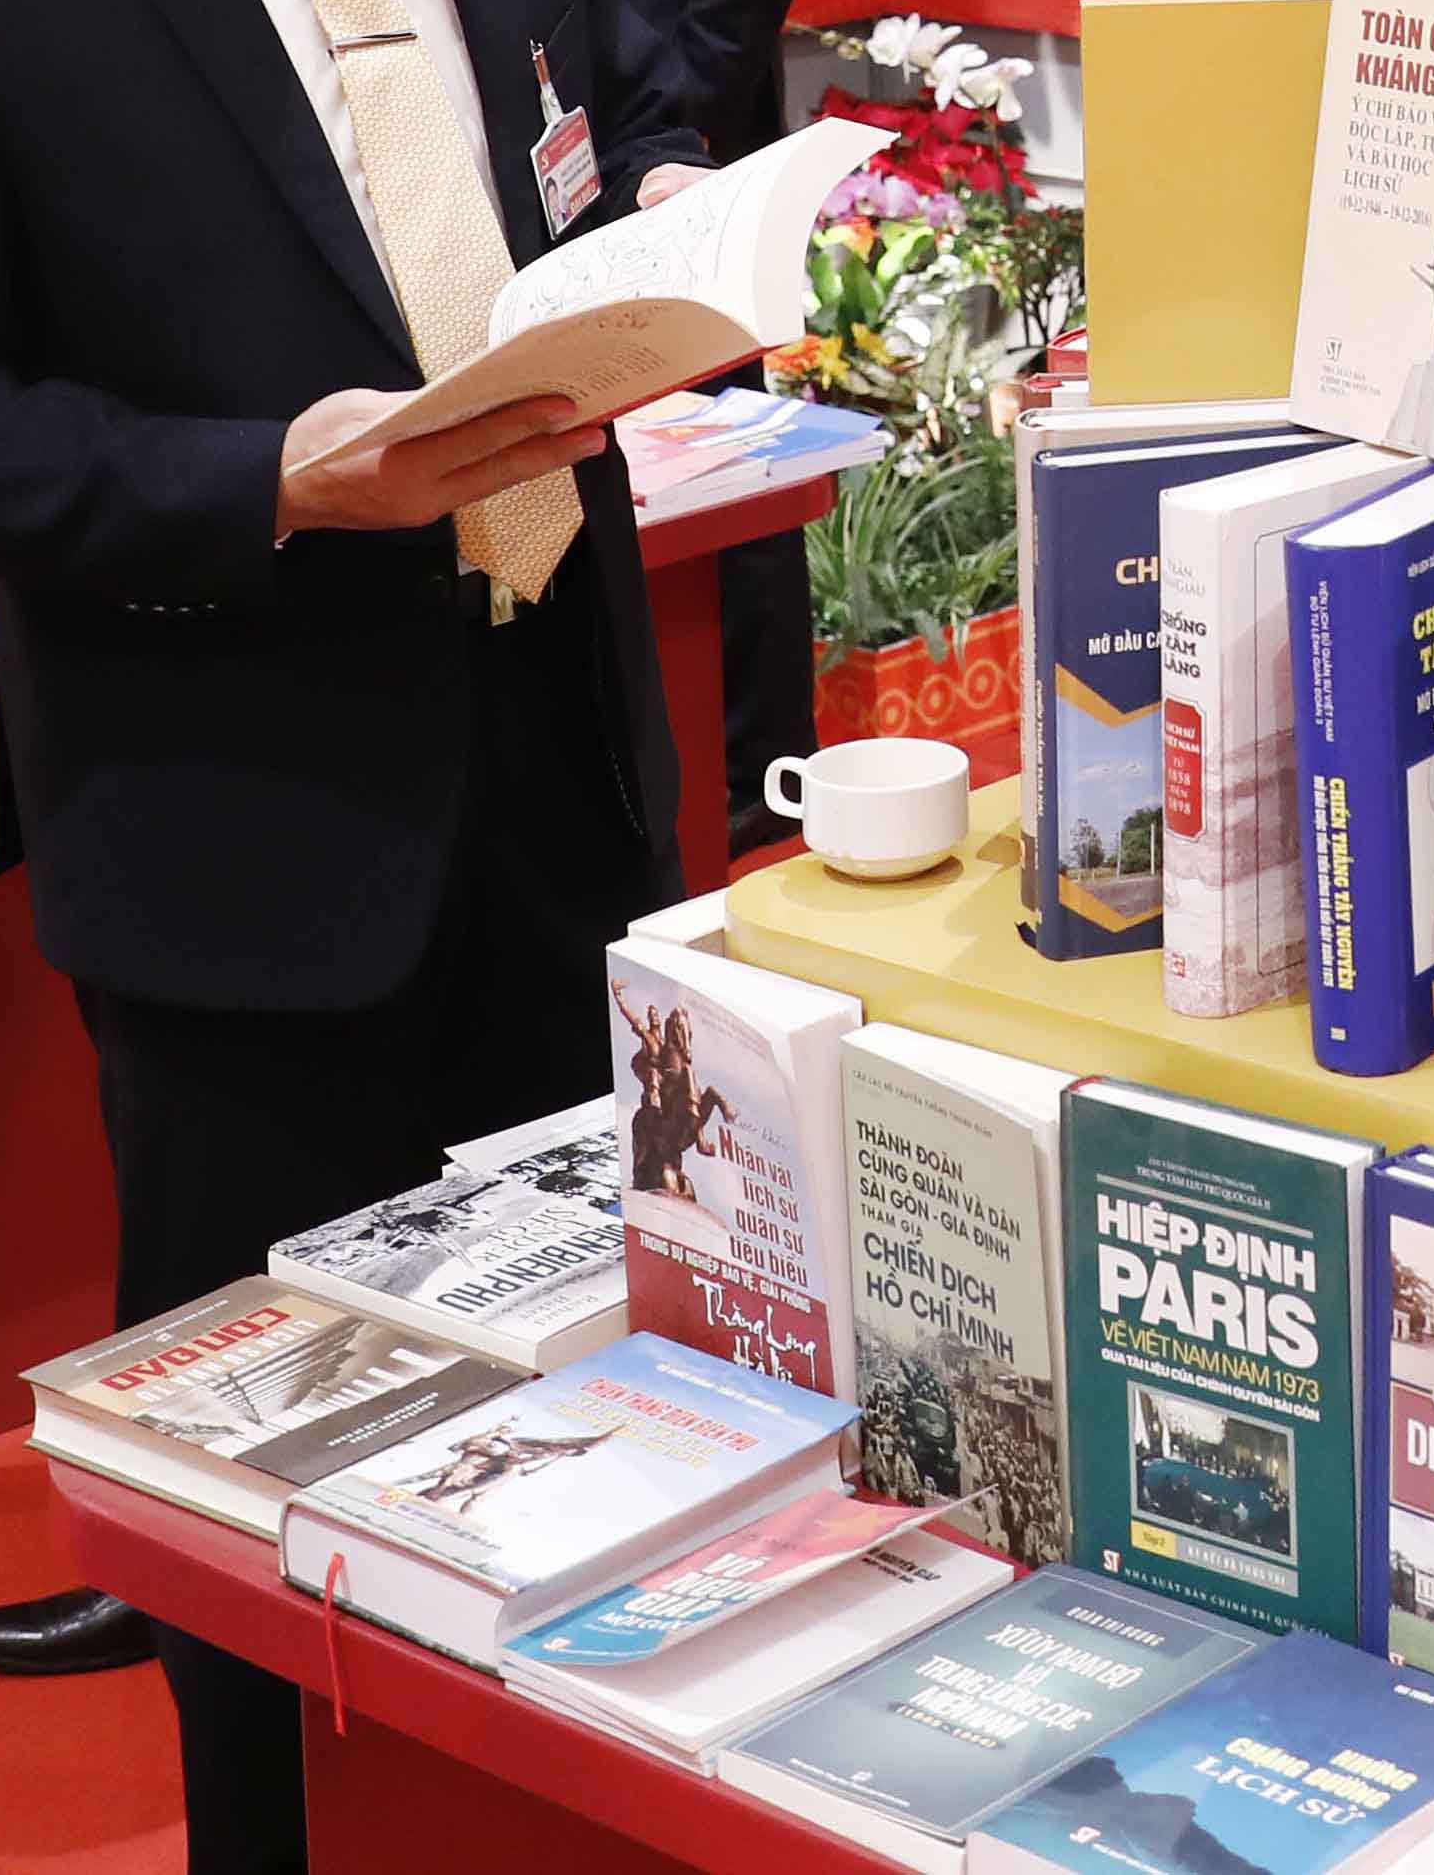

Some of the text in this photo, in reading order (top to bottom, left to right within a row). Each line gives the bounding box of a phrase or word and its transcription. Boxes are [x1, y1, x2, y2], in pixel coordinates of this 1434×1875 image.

[1361, 9, 1423, 50] TOÀN
[1349, 118, 1382, 141] ĐỘC
[1367, 98, 1392, 119] CHÍ
[1397, 101, 1427, 125] BẢO
[1343, 168, 1403, 194] LỊCH SỬ
[1348, 142, 1366, 162] VÀ
[1401, 156, 1432, 177] HỌC
[718, 1126, 793, 1192] Nhân vật
[856, 1119, 964, 1183] THÀNH ĐOÀN
[742, 1175, 799, 1223] lịch sử
[858, 1149, 1022, 1243] CÙNG QUÂN VÀ DÂN
[860, 1176, 1011, 1263] SÀI GÒN GIA ĐỊNH
[861, 1202, 924, 1239] THAM GIA
[729, 1234, 808, 1288] tiêu biểu
[735, 1208, 804, 1258] quân sự
[1096, 1193, 1316, 1293] HIỆP ĐỊNH
[863, 1231, 997, 1315] CHIẾN DỊCH
[866, 1266, 1015, 1365] HỒ CHÍ MINH
[1098, 1243, 1319, 1370] PARIS
[1100, 1316, 1320, 1402] VỀ VIỆT NAM NĂM 1973
[1102, 1549, 1122, 1574] ST
[1191, 1754, 1366, 1825] LỊCH SỬ
